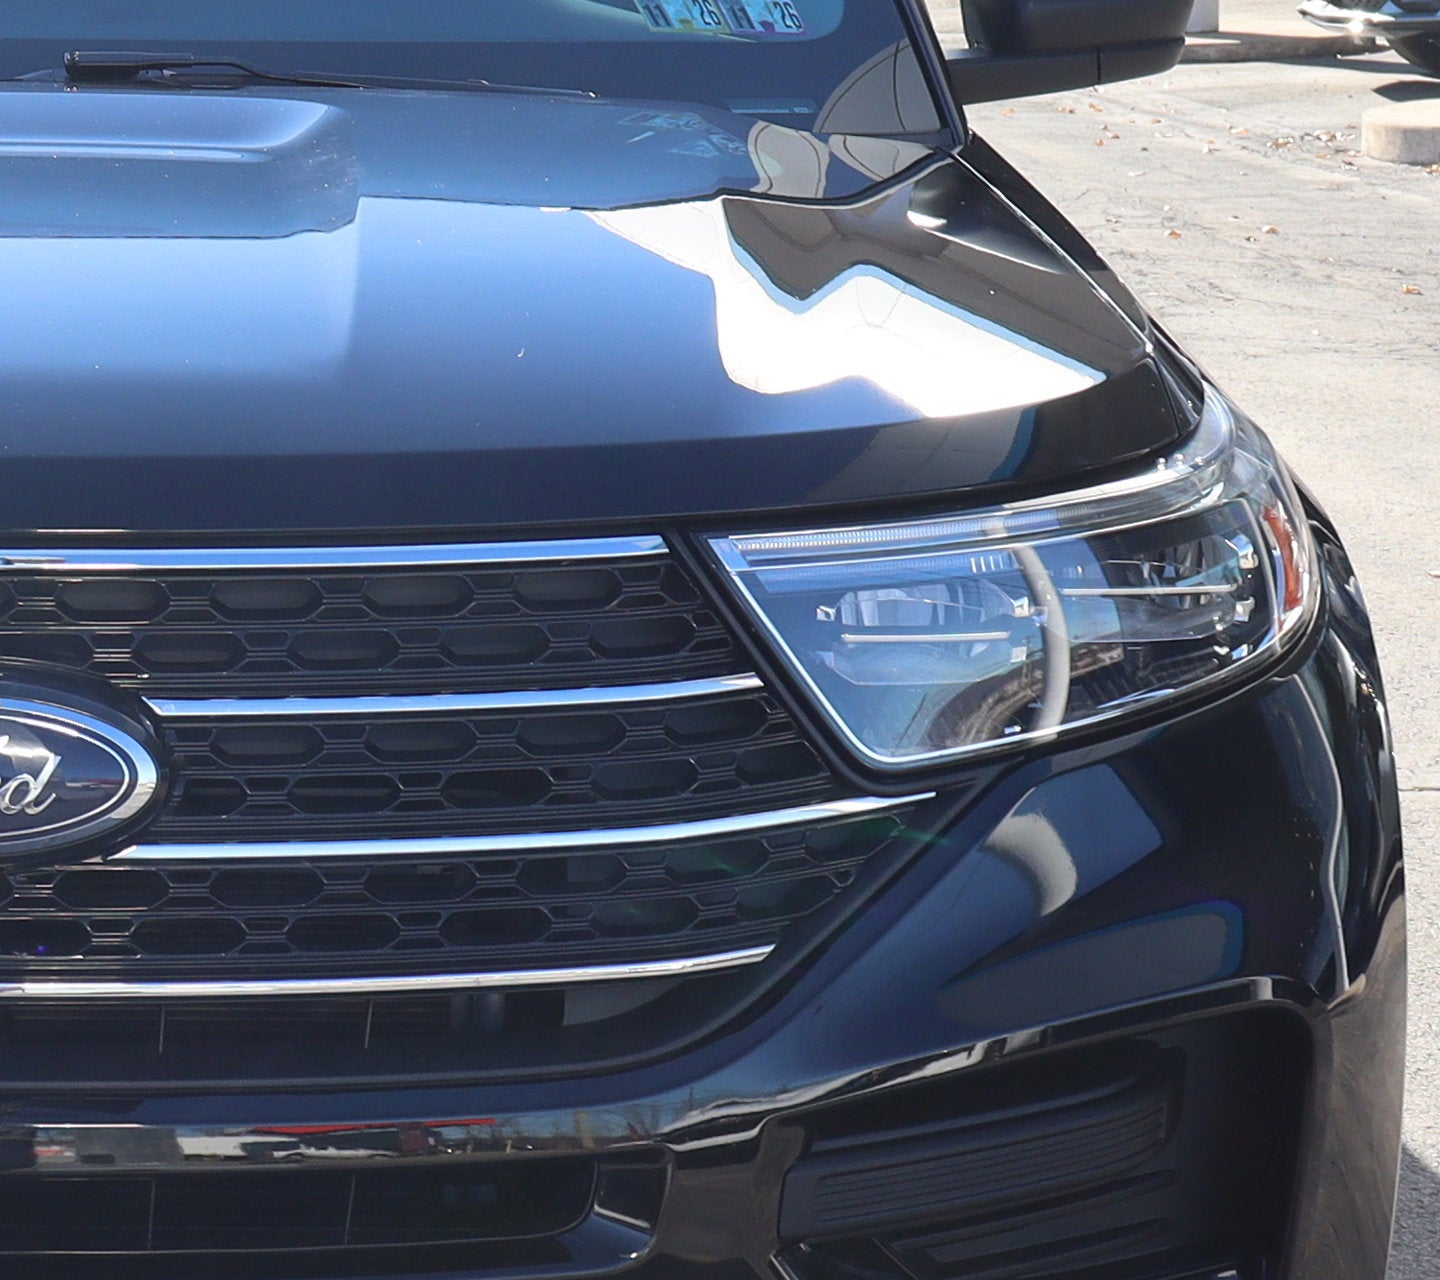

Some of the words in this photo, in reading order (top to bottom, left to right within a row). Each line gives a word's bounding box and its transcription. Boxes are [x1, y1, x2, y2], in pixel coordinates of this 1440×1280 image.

[643, 3, 673, 28] 11
[728, 5, 757, 30] 11
[772, 1, 803, 29] 26
